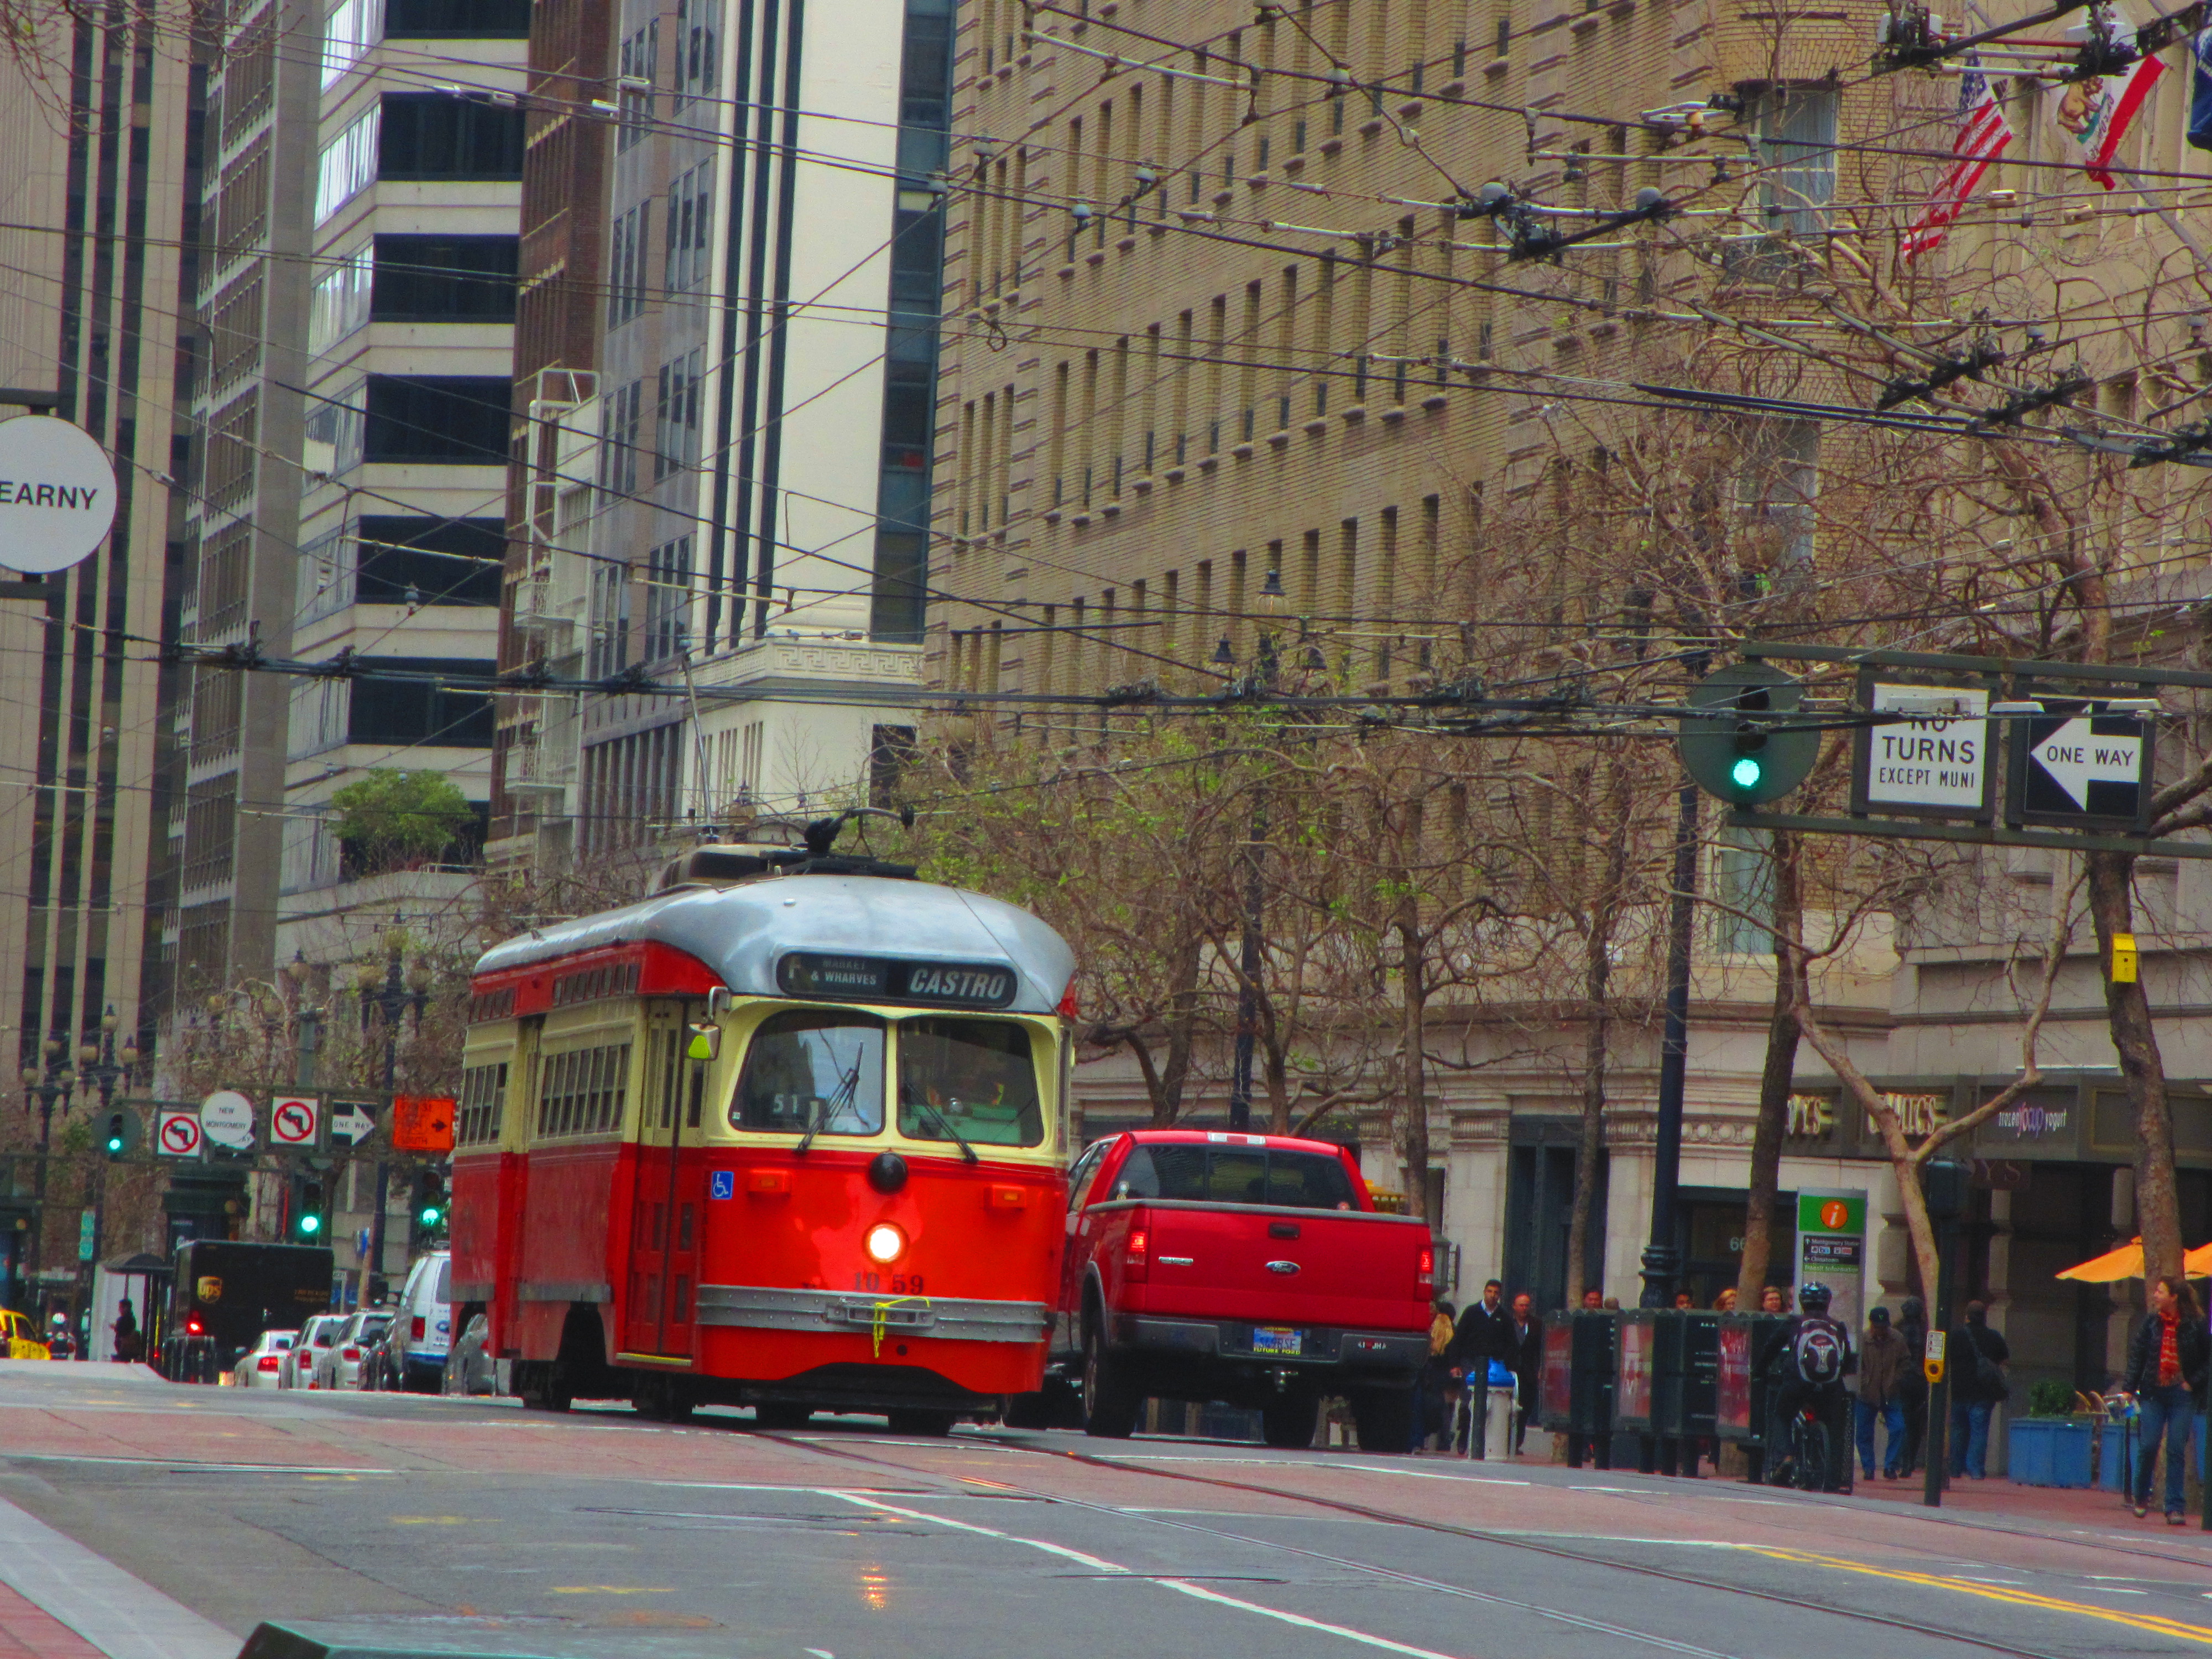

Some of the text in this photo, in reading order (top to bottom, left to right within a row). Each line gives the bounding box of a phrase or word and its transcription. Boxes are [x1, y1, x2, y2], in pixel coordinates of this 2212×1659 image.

[1882, 735, 1975, 764] TURNS
[2047, 745, 2135, 767] ONE WAY
[1880, 767, 1975, 788] EXCEPT MUNI
[811, 970, 877, 985] & WHARVES
[910, 968, 1006, 999] CASTRO
[205, 1120, 247, 1130] MONTGOMERY
[354, 1121, 371, 1129] WAY
[200, 1284, 221, 1300] ups
